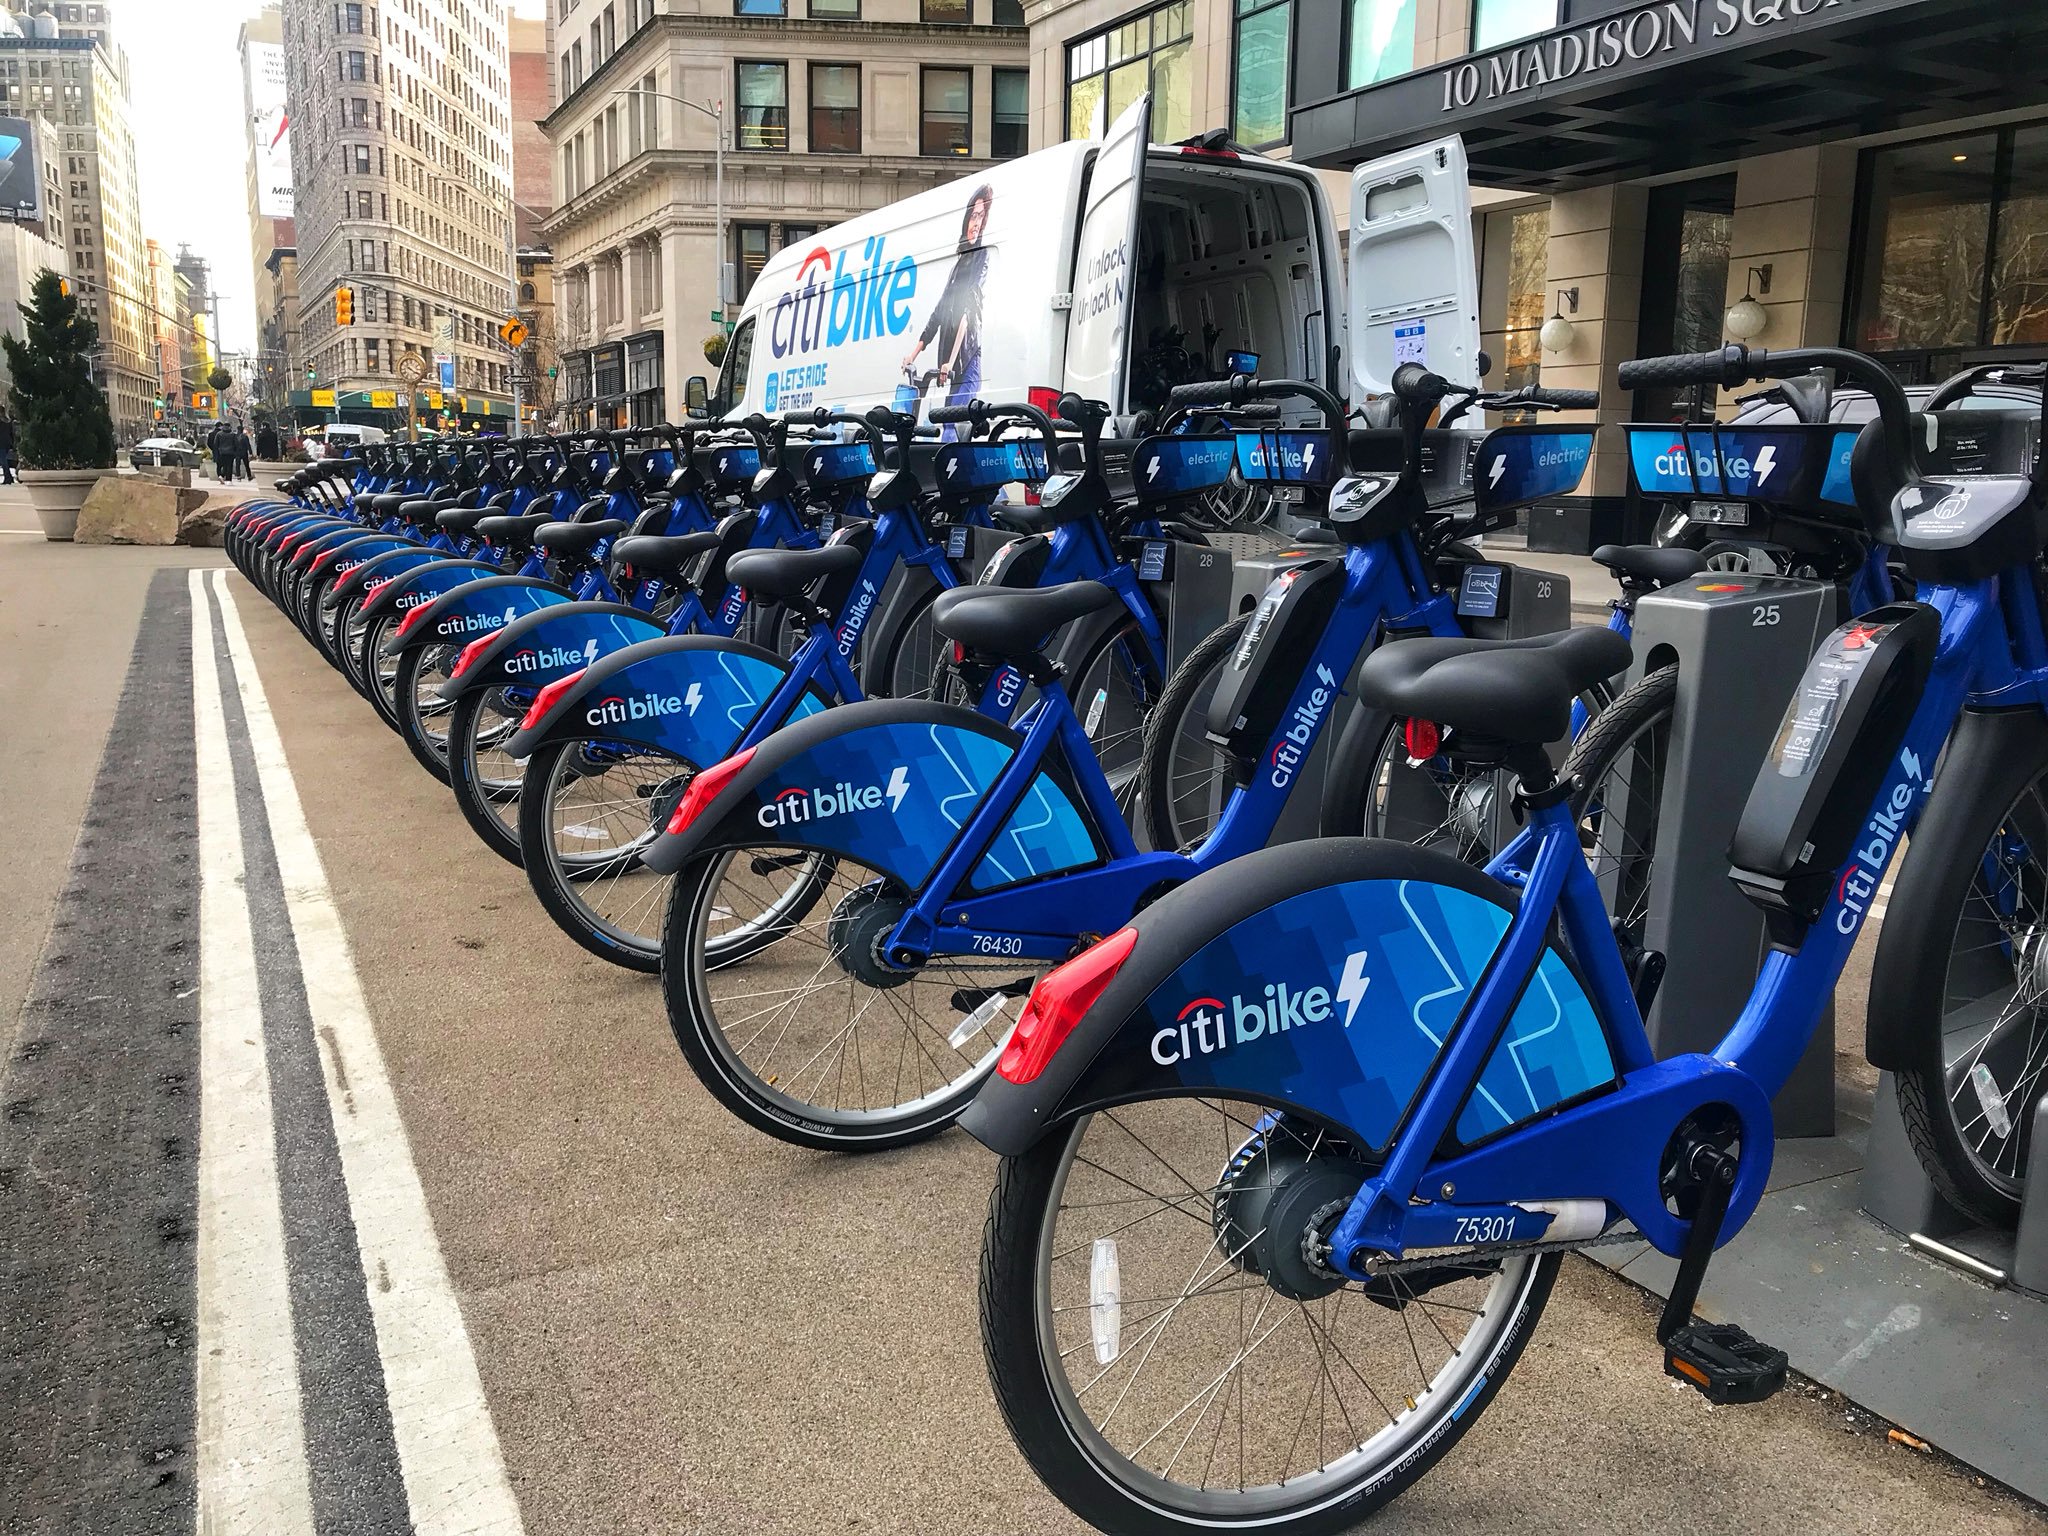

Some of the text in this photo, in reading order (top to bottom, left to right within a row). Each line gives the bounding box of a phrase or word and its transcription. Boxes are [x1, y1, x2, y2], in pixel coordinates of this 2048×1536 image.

[1441, 64, 1480, 111] 10
[1486, 0, 1697, 99] MADISON
[272, 187, 294, 196] MIR
[1088, 238, 1126, 284] Unlock
[1078, 282, 1111, 326] Unlock
[780, 363, 828, 391] LET'S RIDE
[779, 395, 790, 411] GET
[843, 454, 863, 463] elect
[981, 456, 1008, 467] electr
[1188, 450, 1228, 465] electric
[1539, 447, 1585, 467] electric
[1200, 554, 1213, 567] 28
[644, 580, 661, 600] citi
[1537, 581, 1552, 598] 26
[723, 599, 742, 625] citi
[1752, 605, 1781, 626] 25
[996, 671, 1021, 707] citi
[972, 935, 1022, 955] 76430
[765, 1105, 826, 1133] KWICK JOURNEY
[1454, 1216, 1516, 1244] 75301
[1365, 1303, 1530, 1496] SCHWALBE MARATHON PLUS
